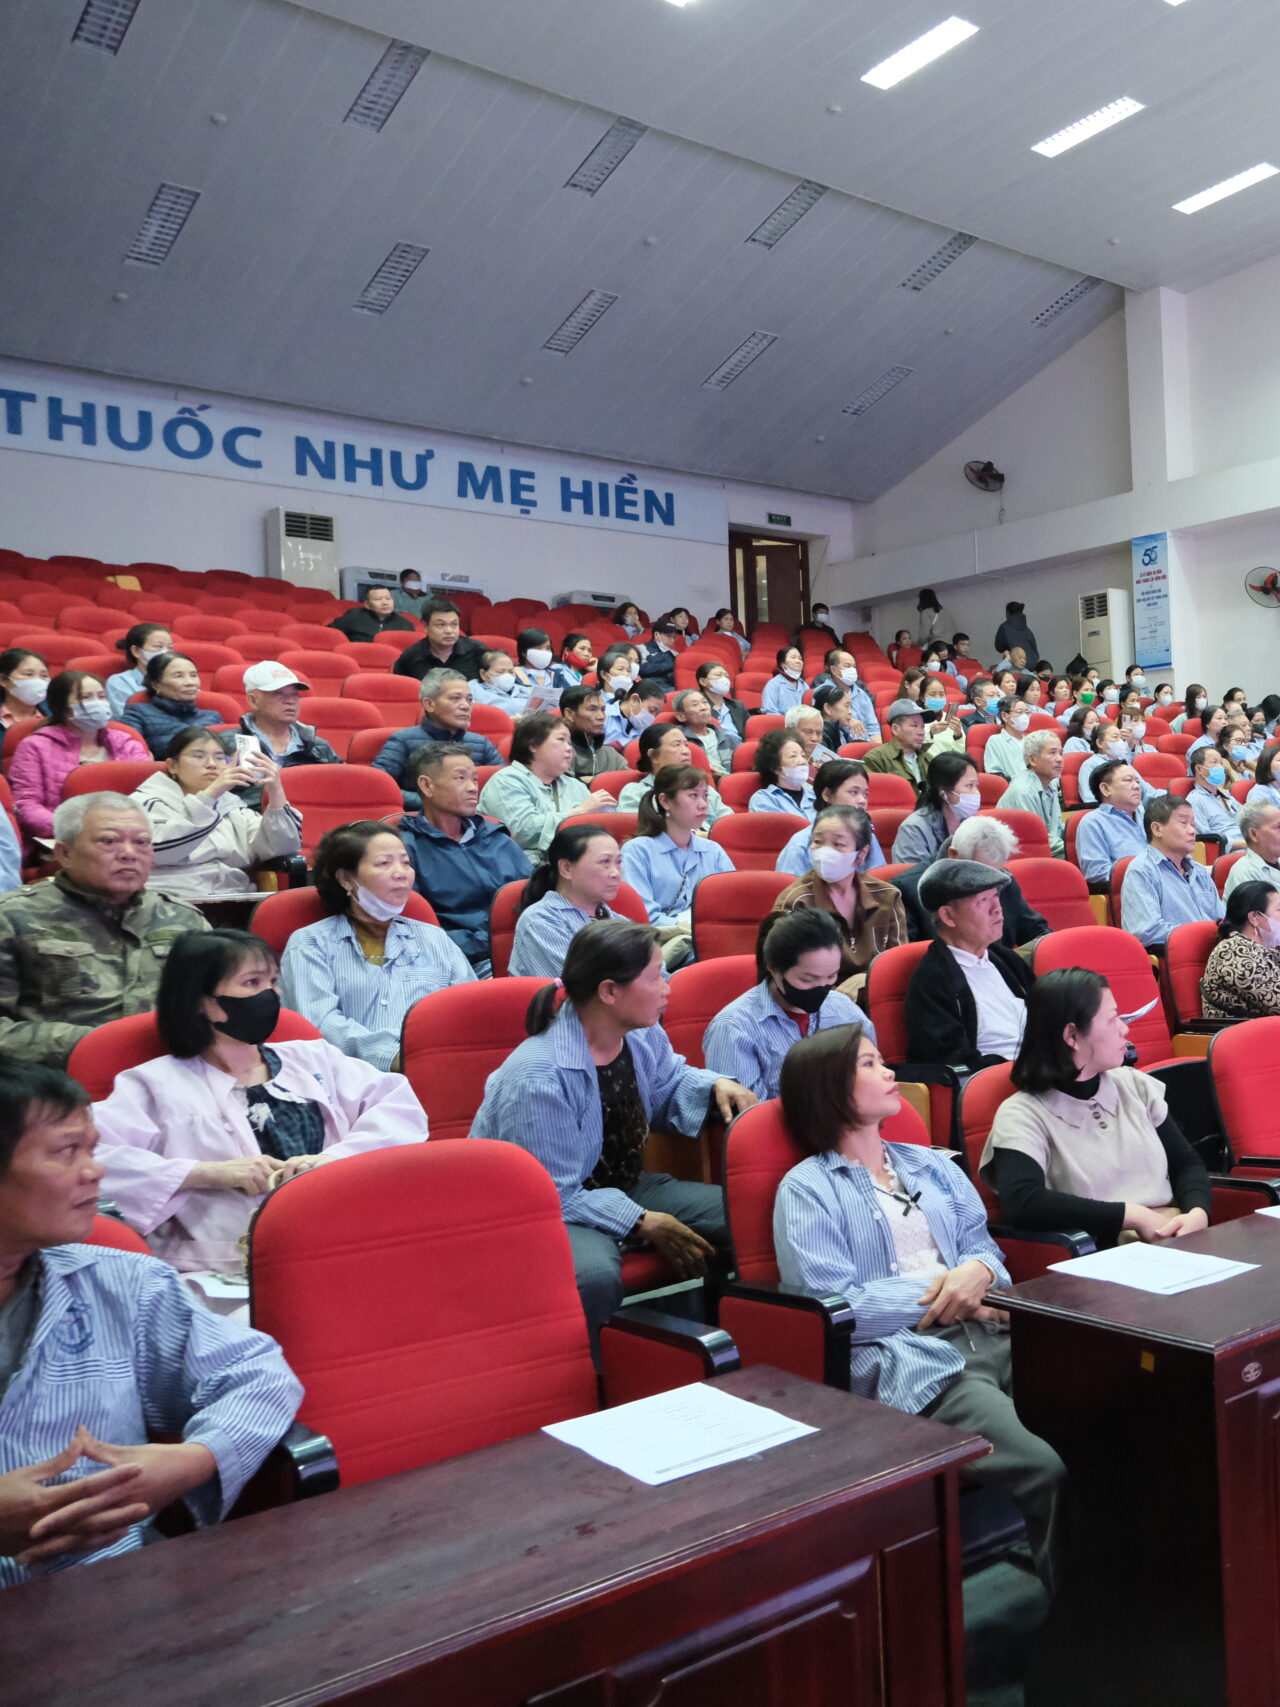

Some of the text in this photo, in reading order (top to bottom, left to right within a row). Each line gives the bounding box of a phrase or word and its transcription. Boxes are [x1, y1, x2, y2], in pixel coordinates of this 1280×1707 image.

[0, 388, 676, 526] THUỐC NHƯ MẸ HIỀN
